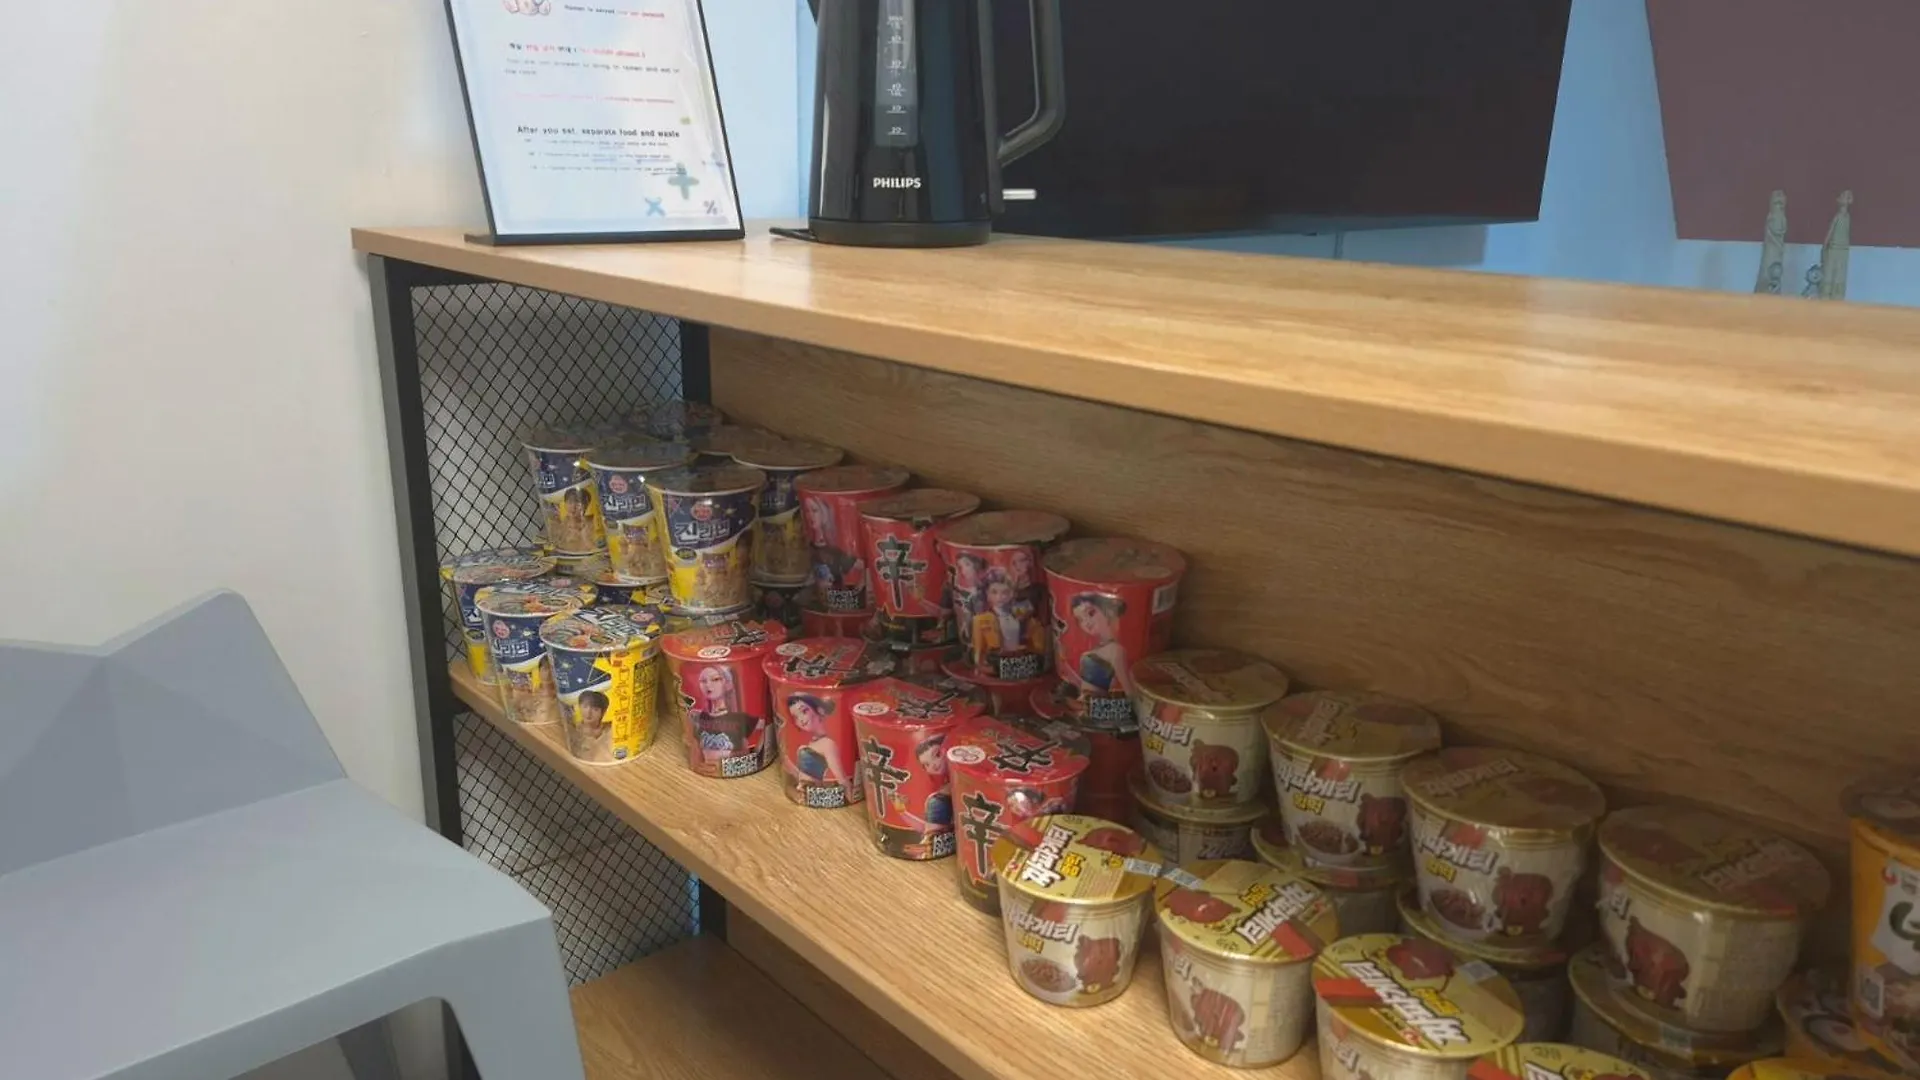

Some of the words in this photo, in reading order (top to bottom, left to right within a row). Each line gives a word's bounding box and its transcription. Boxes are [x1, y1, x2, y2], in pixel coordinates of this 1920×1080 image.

[517, 125, 538, 134] After
[543, 127, 559, 135] you
[582, 128, 616, 136] separate
[620, 128, 637, 136] food
[641, 129, 655, 137] and
[873, 177, 921, 189] PHILIPS
[674, 519, 731, 545] 진라면
[876, 533, 928, 611] 辛
[857, 735, 911, 819] 辛
